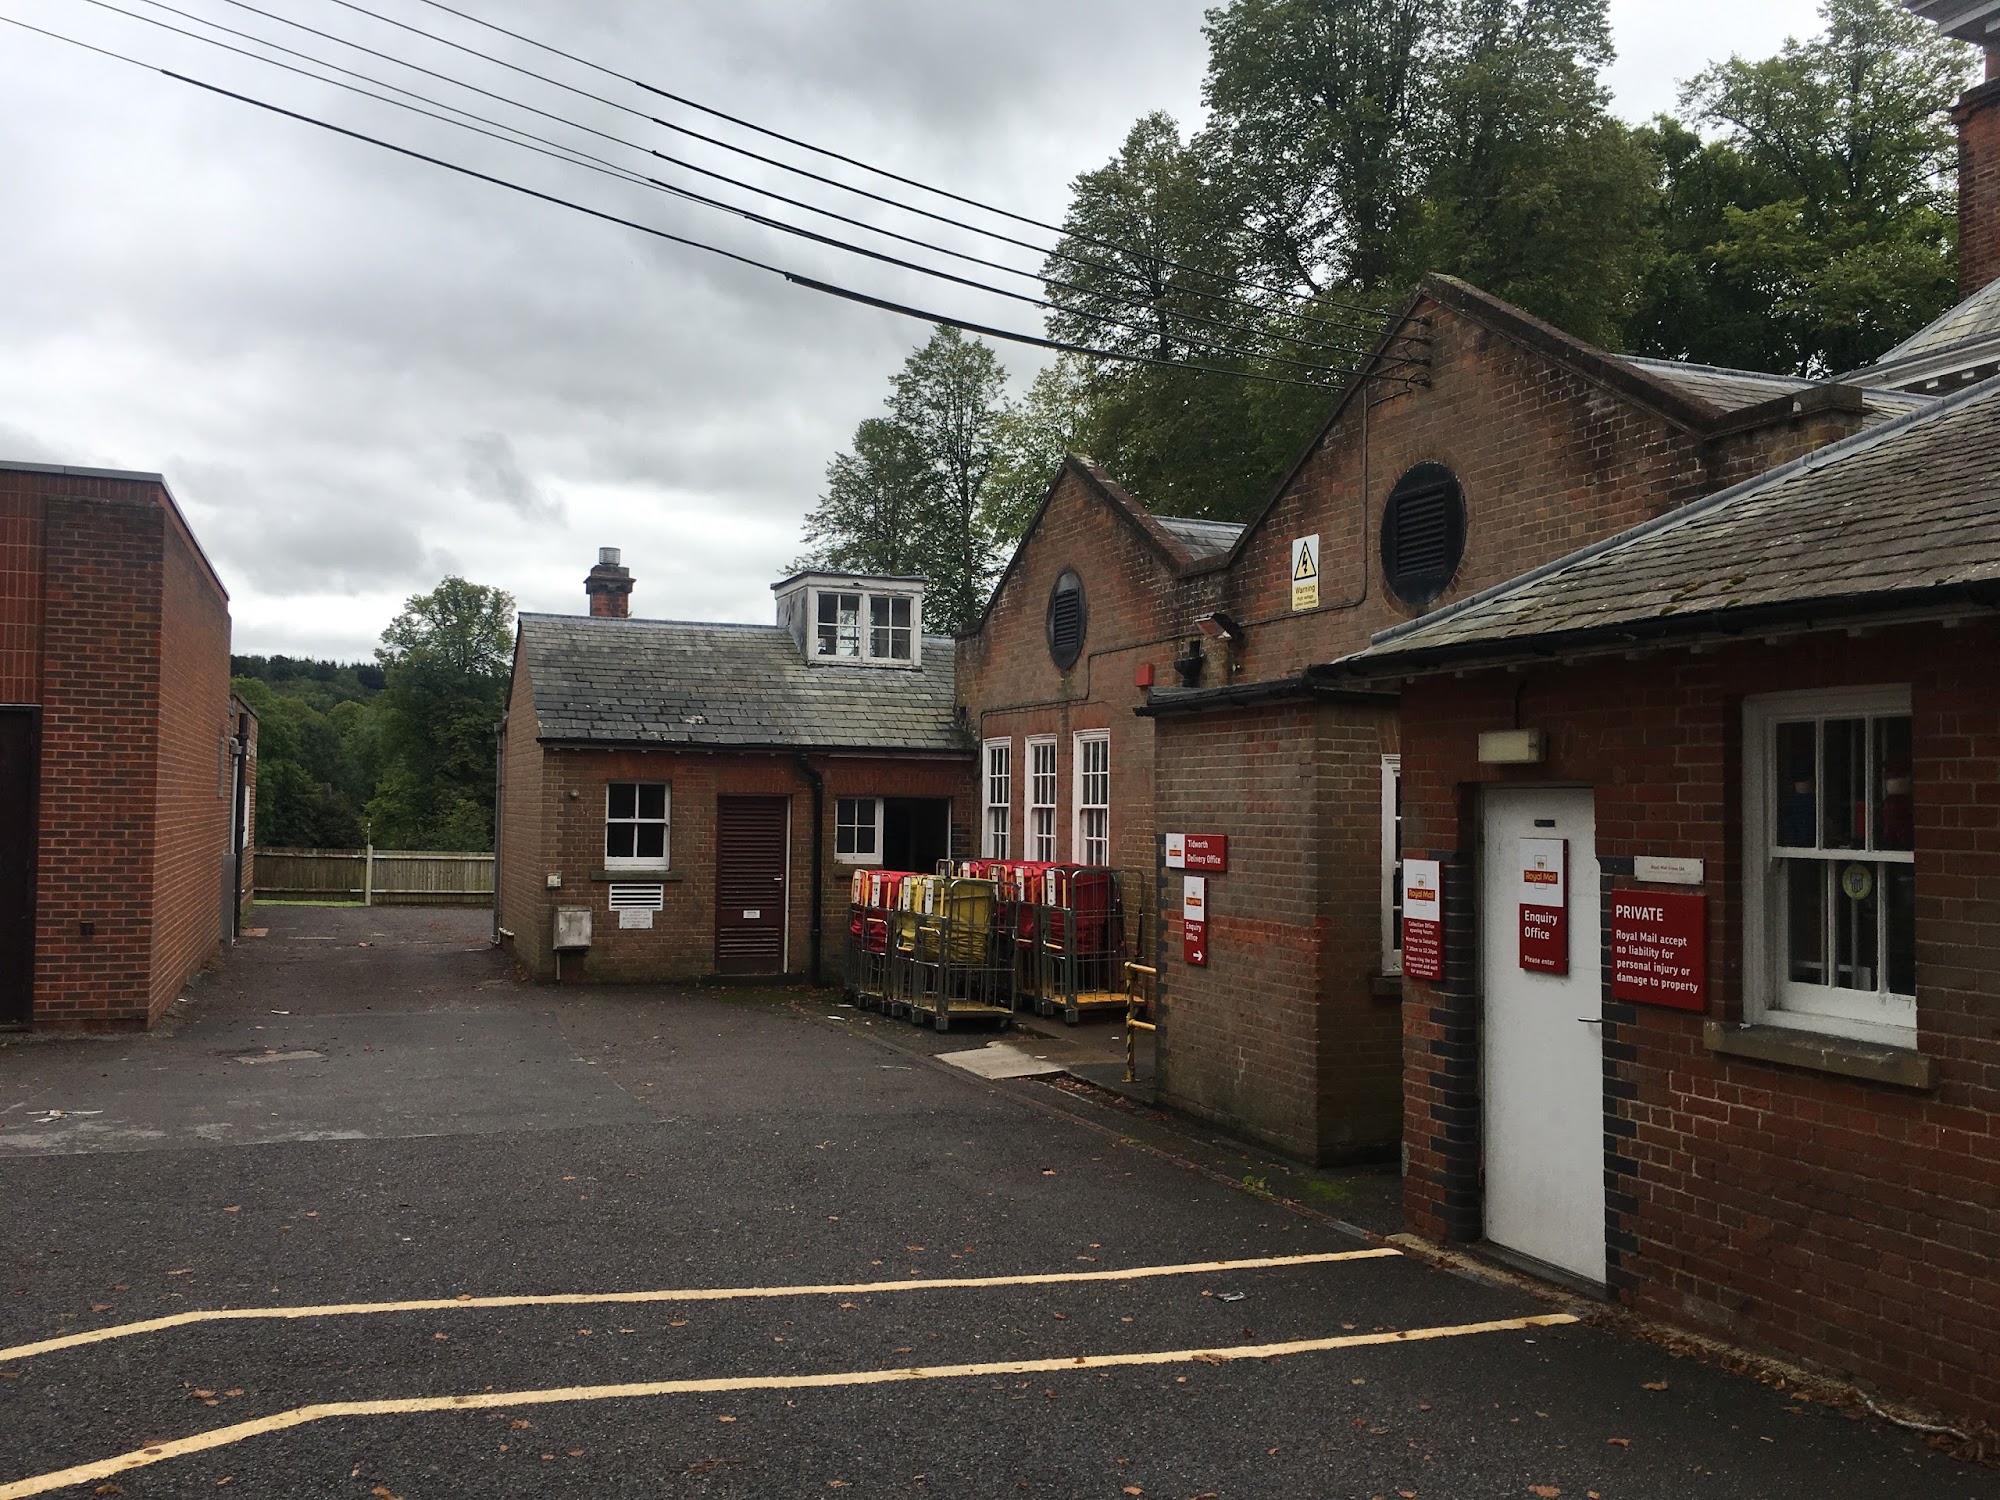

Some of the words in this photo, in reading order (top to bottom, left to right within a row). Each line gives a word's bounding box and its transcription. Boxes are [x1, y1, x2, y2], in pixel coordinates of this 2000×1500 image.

[1295, 585, 1315, 594] Warning
[1188, 840, 1208, 848] Tidworth
[1187, 854, 1206, 864] Delivery
[1206, 855, 1220, 864] Office
[1526, 872, 1542, 882] Royal
[1542, 872, 1556, 882] Mail
[1408, 890, 1422, 899] Royal
[1422, 890, 1434, 898] Mail
[1524, 910, 1558, 926] Enquiry
[1616, 904, 1664, 922] PRIVATE
[1186, 922, 1202, 932] Enquiry
[1186, 932, 1198, 942] Office
[1524, 926, 1550, 940] Office
[1423, 938, 1438, 946] Saturday
[1616, 930, 1638, 942] Royal
[1640, 932, 1658, 943] Mail
[1660, 936, 1687, 948] accept
[1616, 946, 1626, 954] no
[1628, 944, 1659, 960] liability
[1662, 948, 1674, 959] for
[1524, 955, 1540, 964] Please
[1616, 960, 1650, 972] personal
[1654, 962, 1678, 976] injury
[1681, 968, 1690, 976] or
[1616, 972, 1648, 986] damage
[1650, 977, 1658, 986] to
[1662, 980, 1698, 994] property
